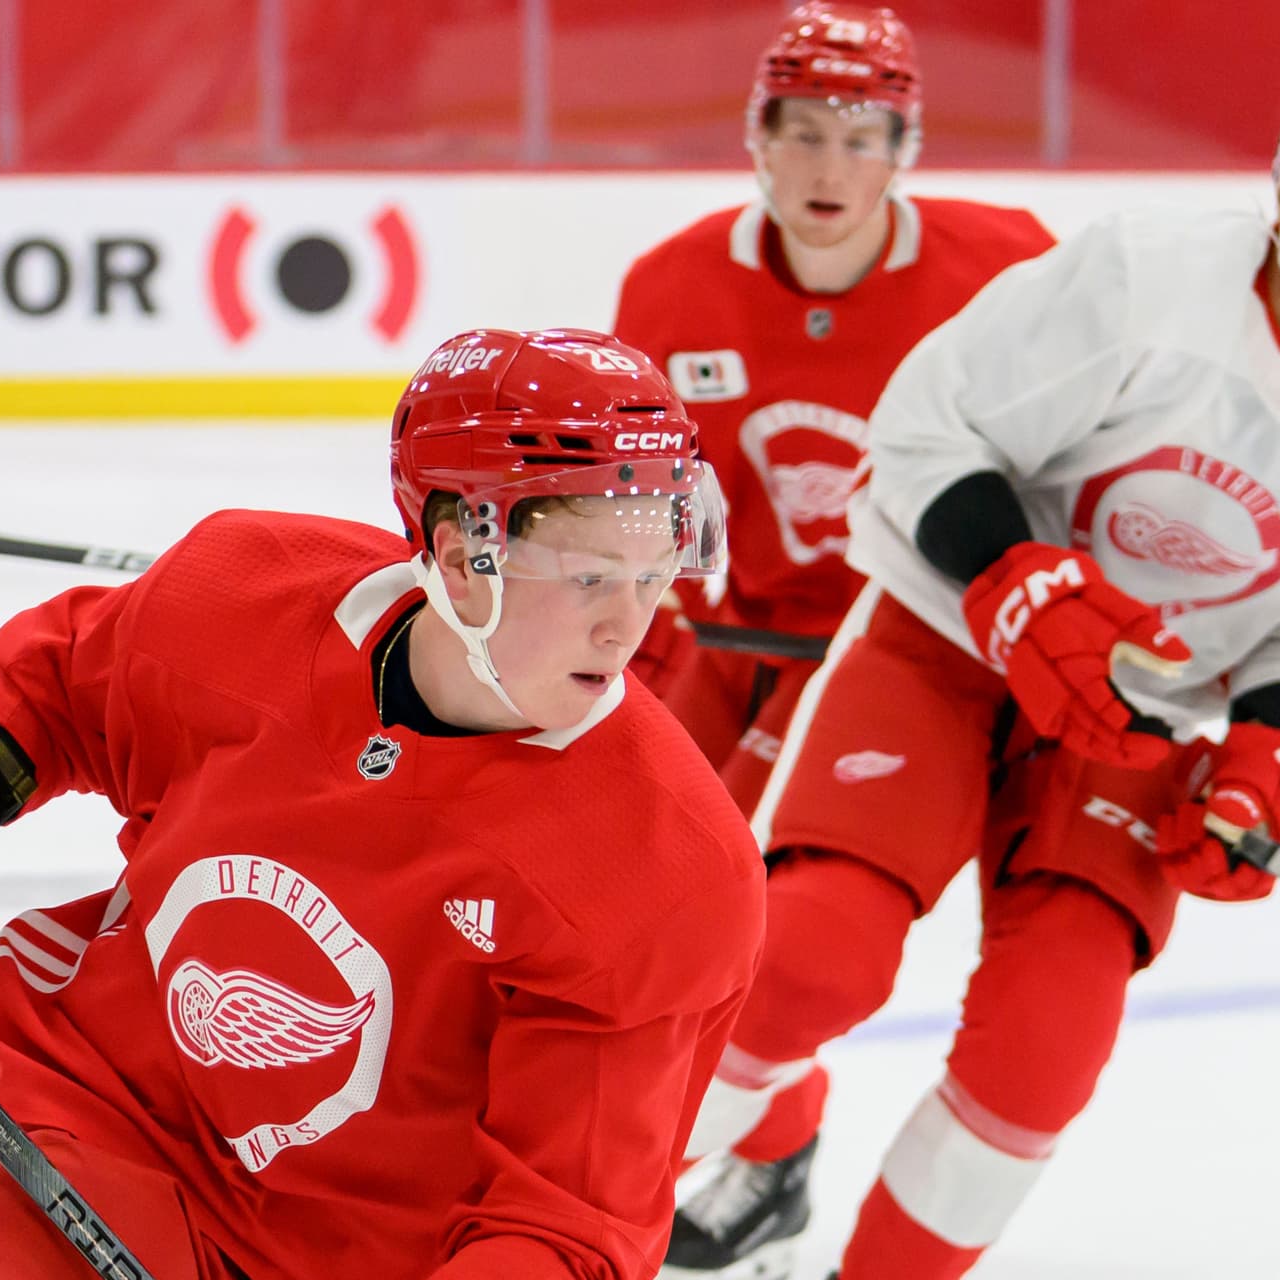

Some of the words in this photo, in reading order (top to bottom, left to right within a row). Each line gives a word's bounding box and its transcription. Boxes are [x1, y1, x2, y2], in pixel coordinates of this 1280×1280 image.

[573, 348, 638, 371] 26
[614, 432, 684, 451] CCM
[218, 859, 364, 961] DETROIT
[443, 900, 496, 953] adidas
